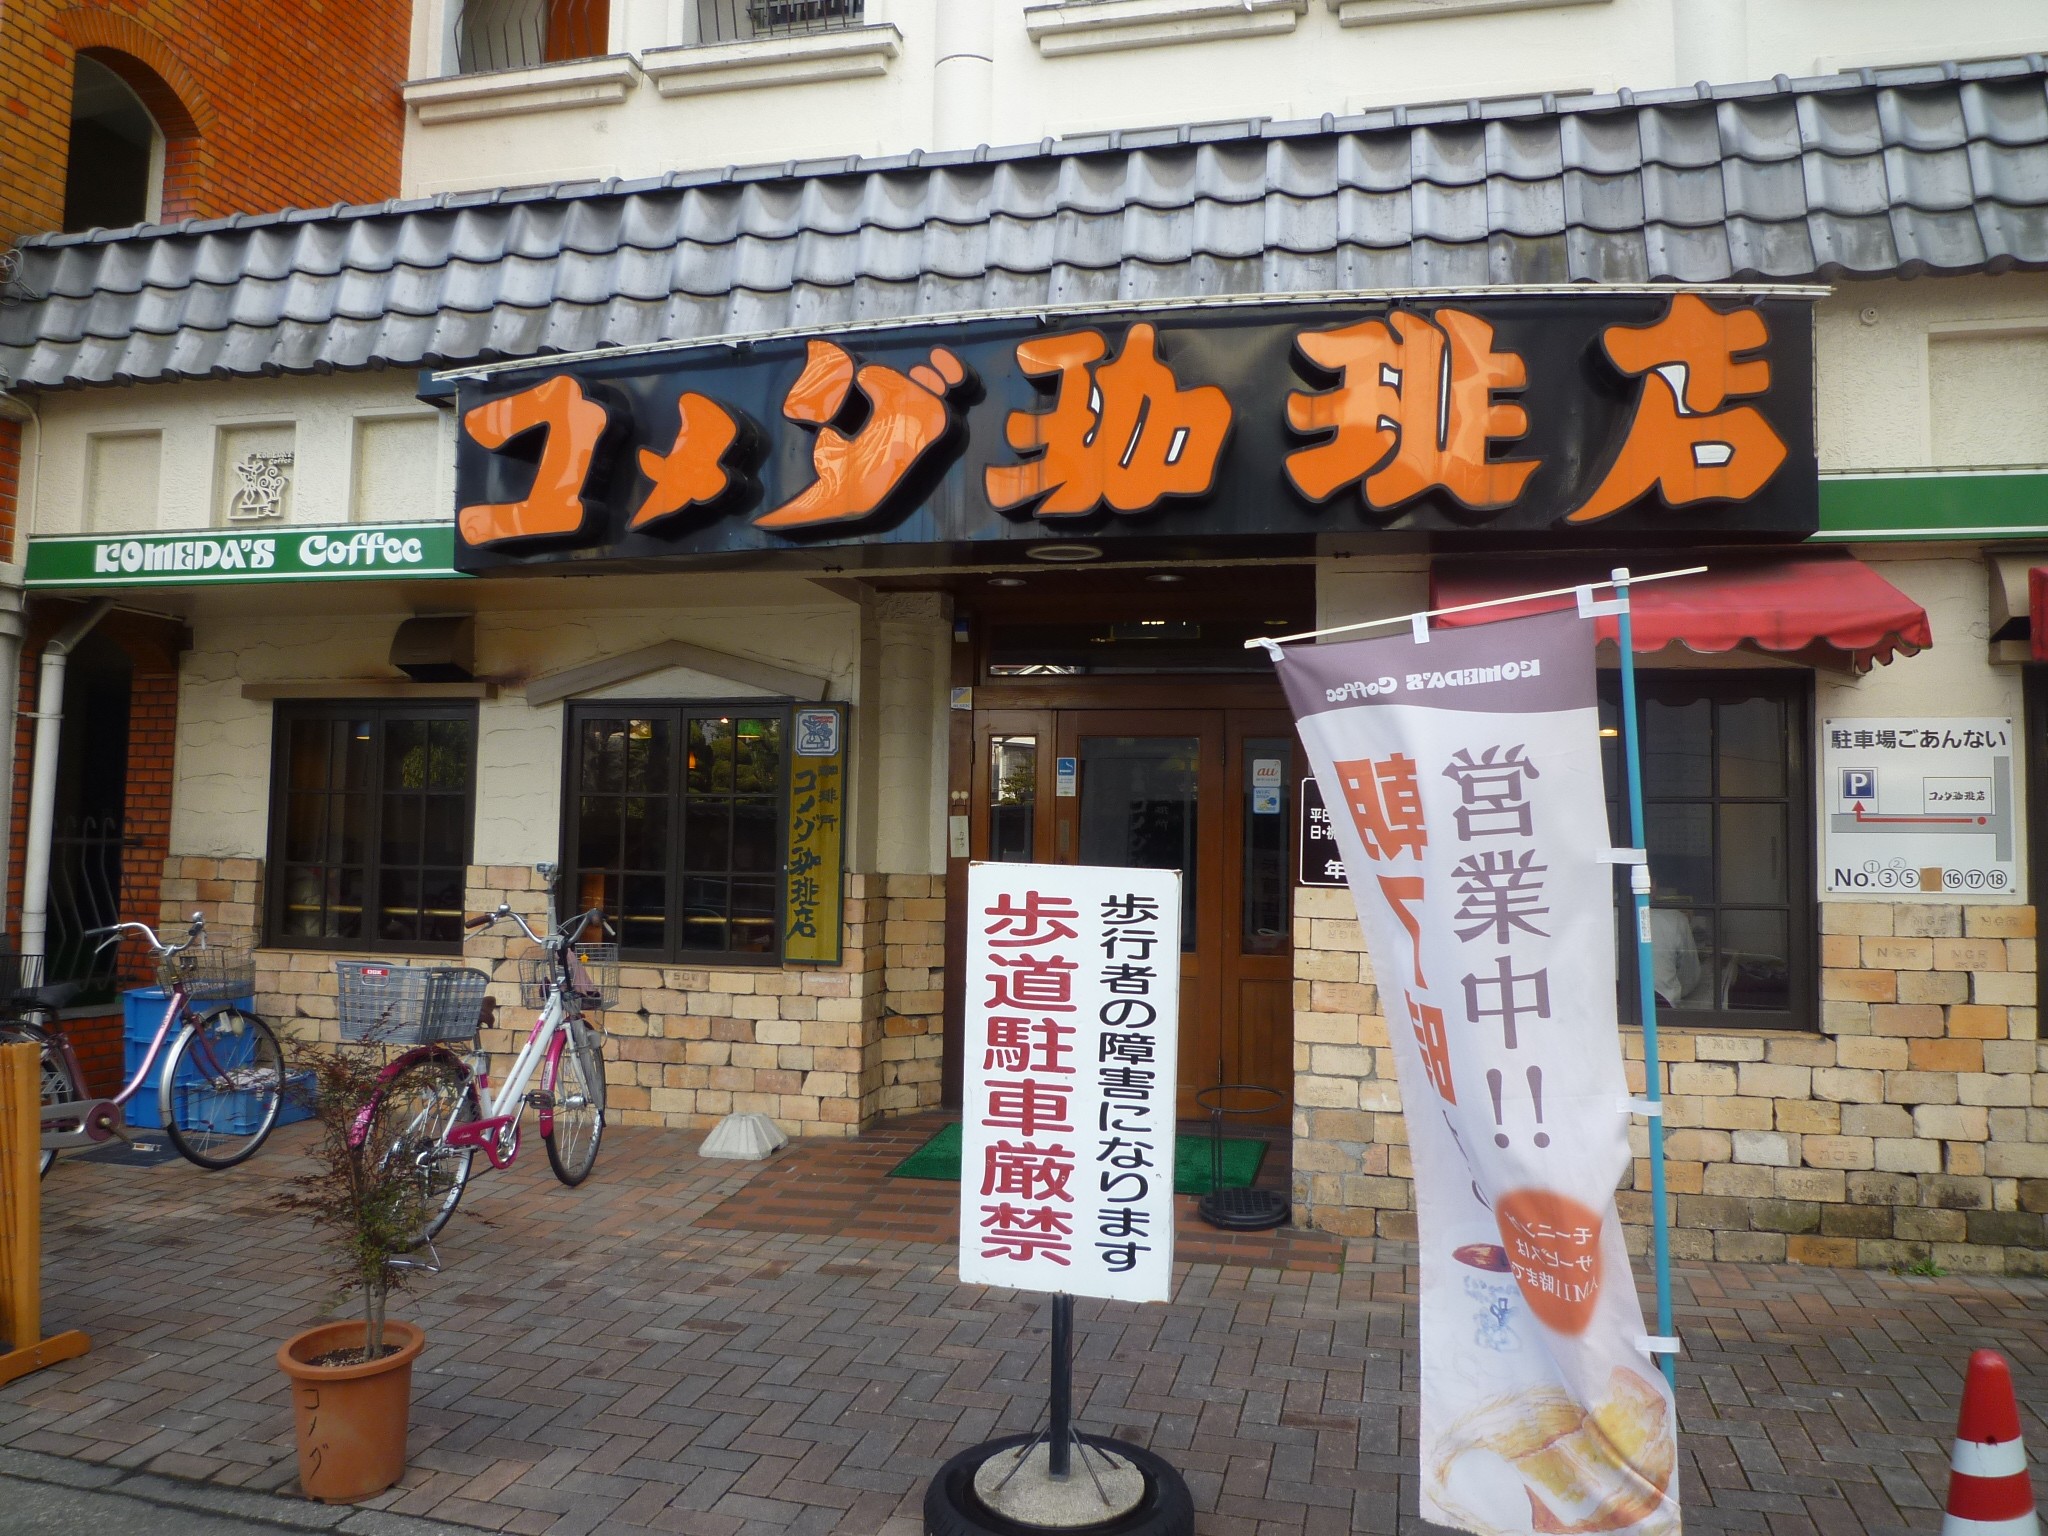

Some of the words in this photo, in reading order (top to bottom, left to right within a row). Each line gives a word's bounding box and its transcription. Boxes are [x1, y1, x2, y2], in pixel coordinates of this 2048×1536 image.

[459, 293, 1788, 545] コメダ珈琲店
[94, 538, 275, 573] KOMEDA'S
[299, 532, 423, 567] Coffee
[1830, 729, 2006, 749] 駐車場ごあんない
[786, 769, 822, 941] コメダ珈琲店
[979, 889, 1080, 1268] 歩道駐車厳禁
[1094, 892, 1160, 1273] 歩行者の障害になります
